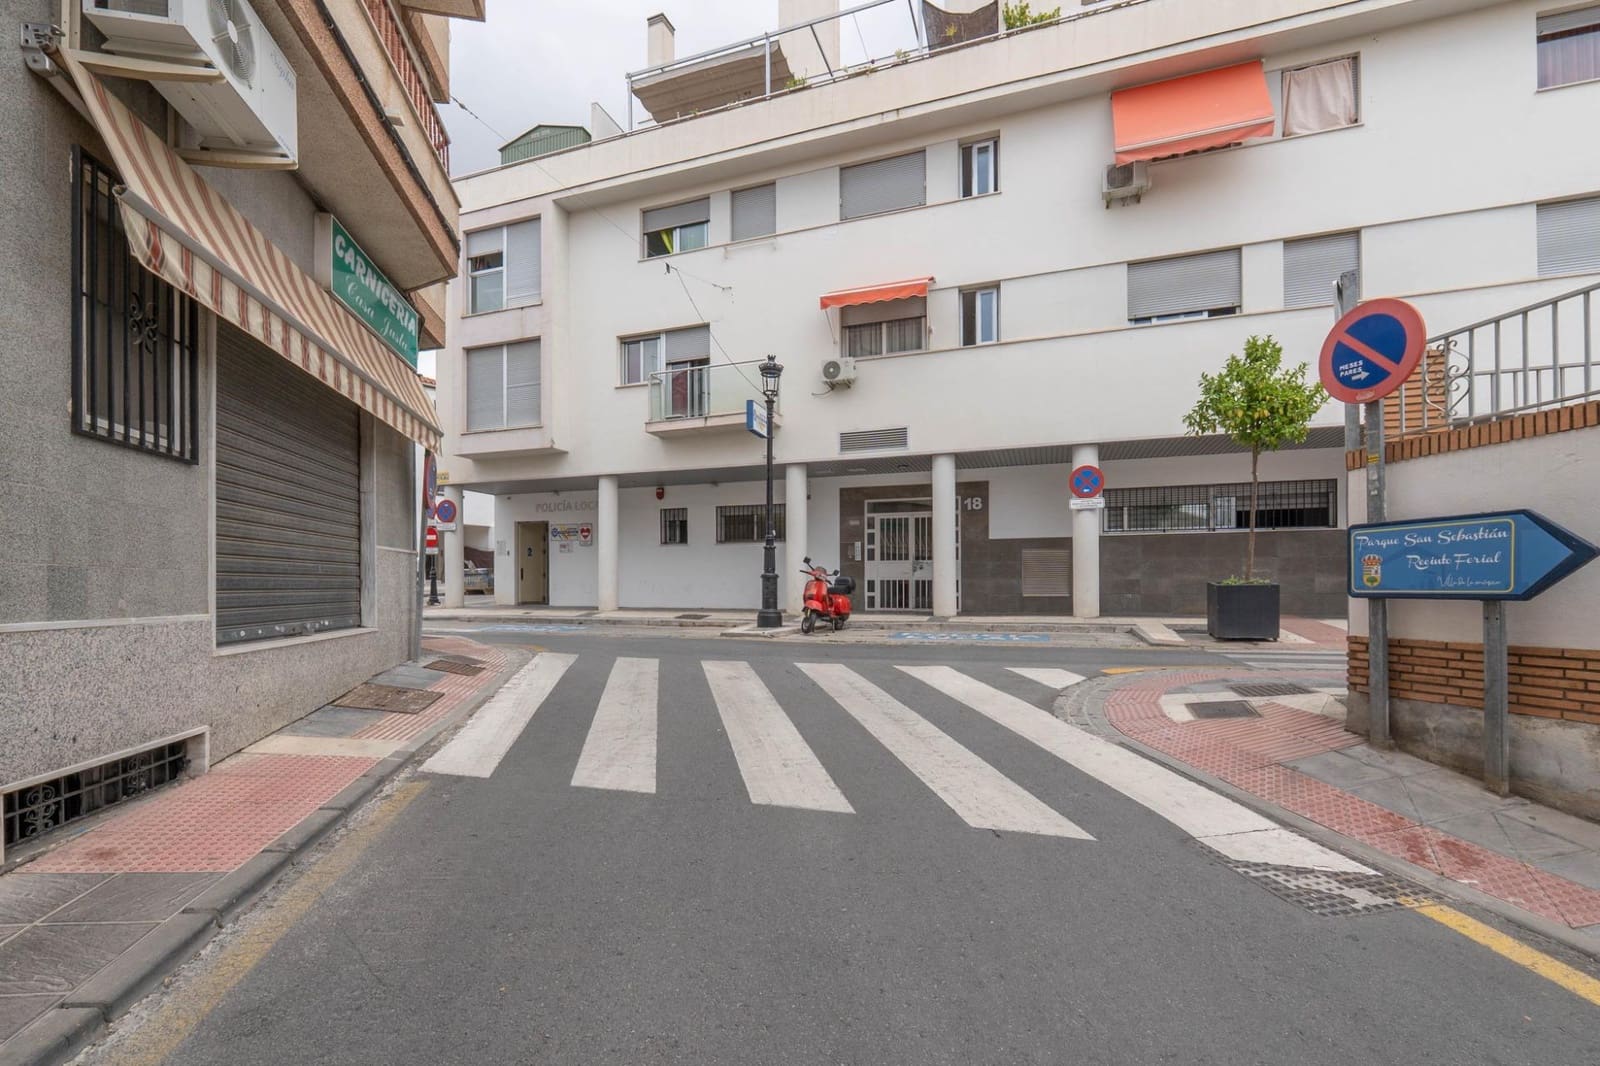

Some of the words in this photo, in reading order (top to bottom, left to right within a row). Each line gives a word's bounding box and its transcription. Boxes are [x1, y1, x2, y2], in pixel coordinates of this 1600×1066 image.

[345, 275, 375, 319] Casa
[1339, 360, 1363, 370] MESES
[1340, 366, 1362, 377] PARES
[964, 497, 982, 510] 18
[1356, 536, 1399, 550] Parque
[1404, 533, 1432, 547] San
[1437, 527, 1508, 544] Sebastián
[1406, 555, 1451, 570] Recinto
[1453, 552, 1501, 570] Ferial
